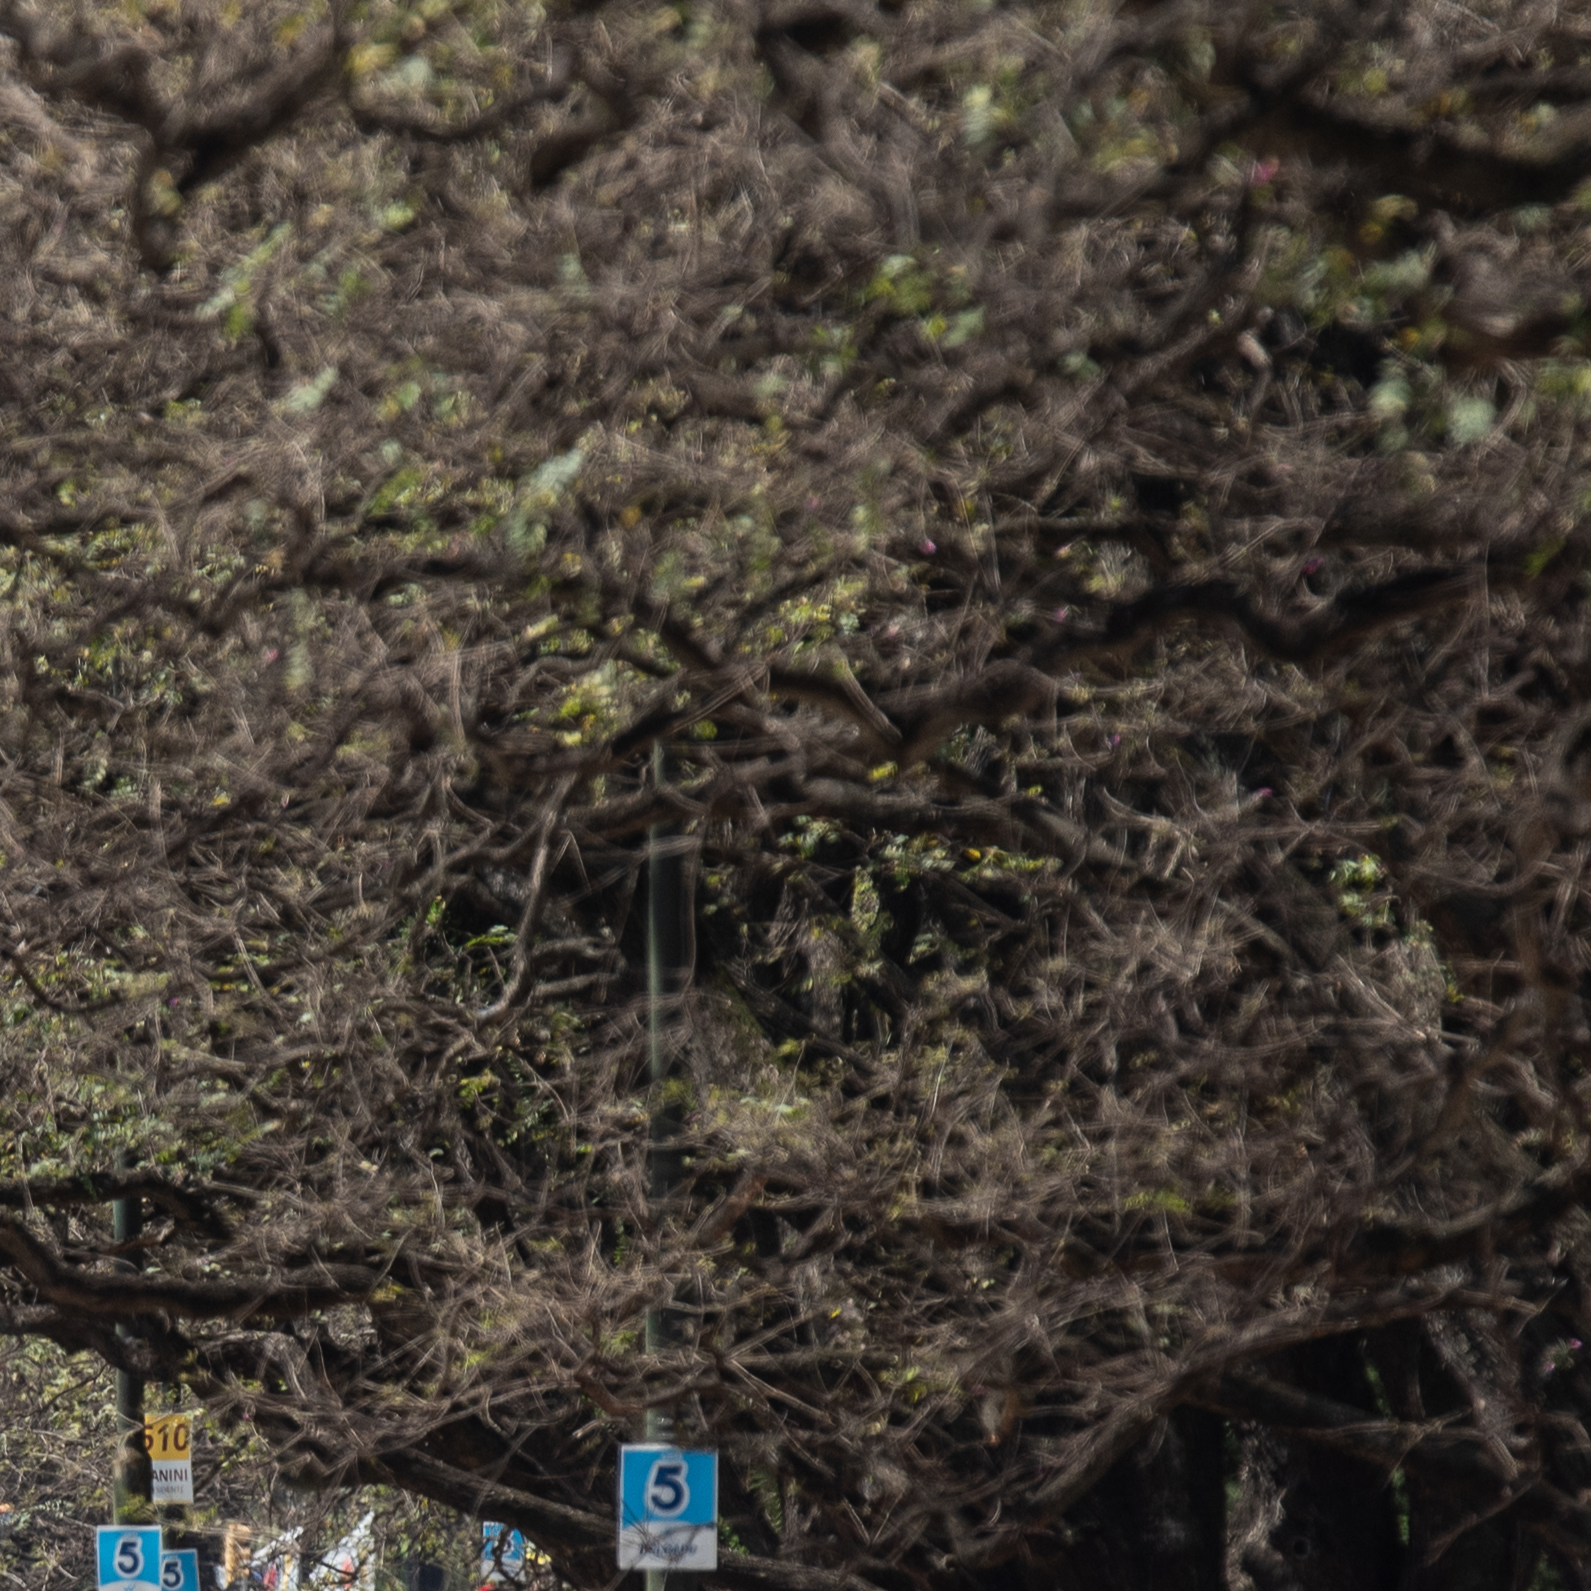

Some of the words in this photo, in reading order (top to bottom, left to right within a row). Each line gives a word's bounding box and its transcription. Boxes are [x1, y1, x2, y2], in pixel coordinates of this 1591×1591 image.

[152, 1468, 188, 1482] ANINI
[650, 1465, 685, 1511] 5
[118, 1542, 140, 1575] 5
[162, 1561, 182, 1588] 5
